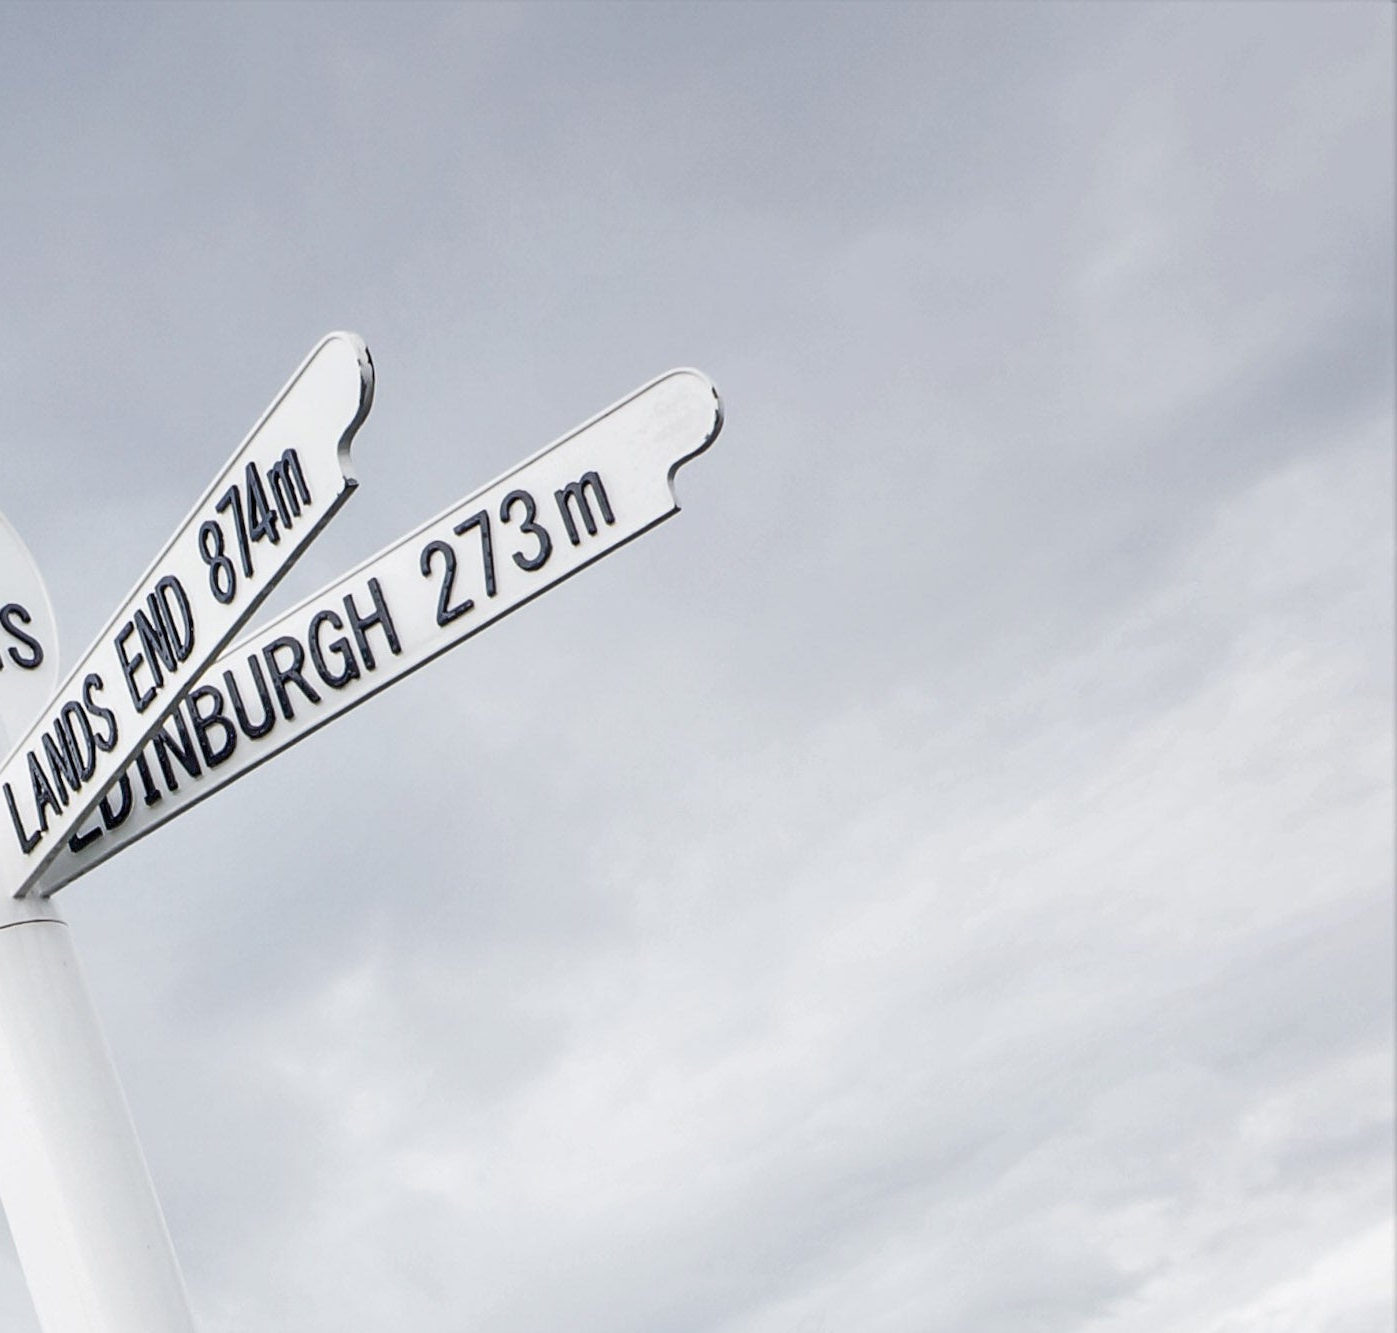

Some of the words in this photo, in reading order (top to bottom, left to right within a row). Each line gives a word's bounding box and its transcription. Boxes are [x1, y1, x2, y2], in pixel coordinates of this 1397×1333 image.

[2, 673, 119, 855] LANDS
[114, 575, 195, 714] END
[198, 448, 312, 605] 874m
[420, 470, 616, 627] 273m
